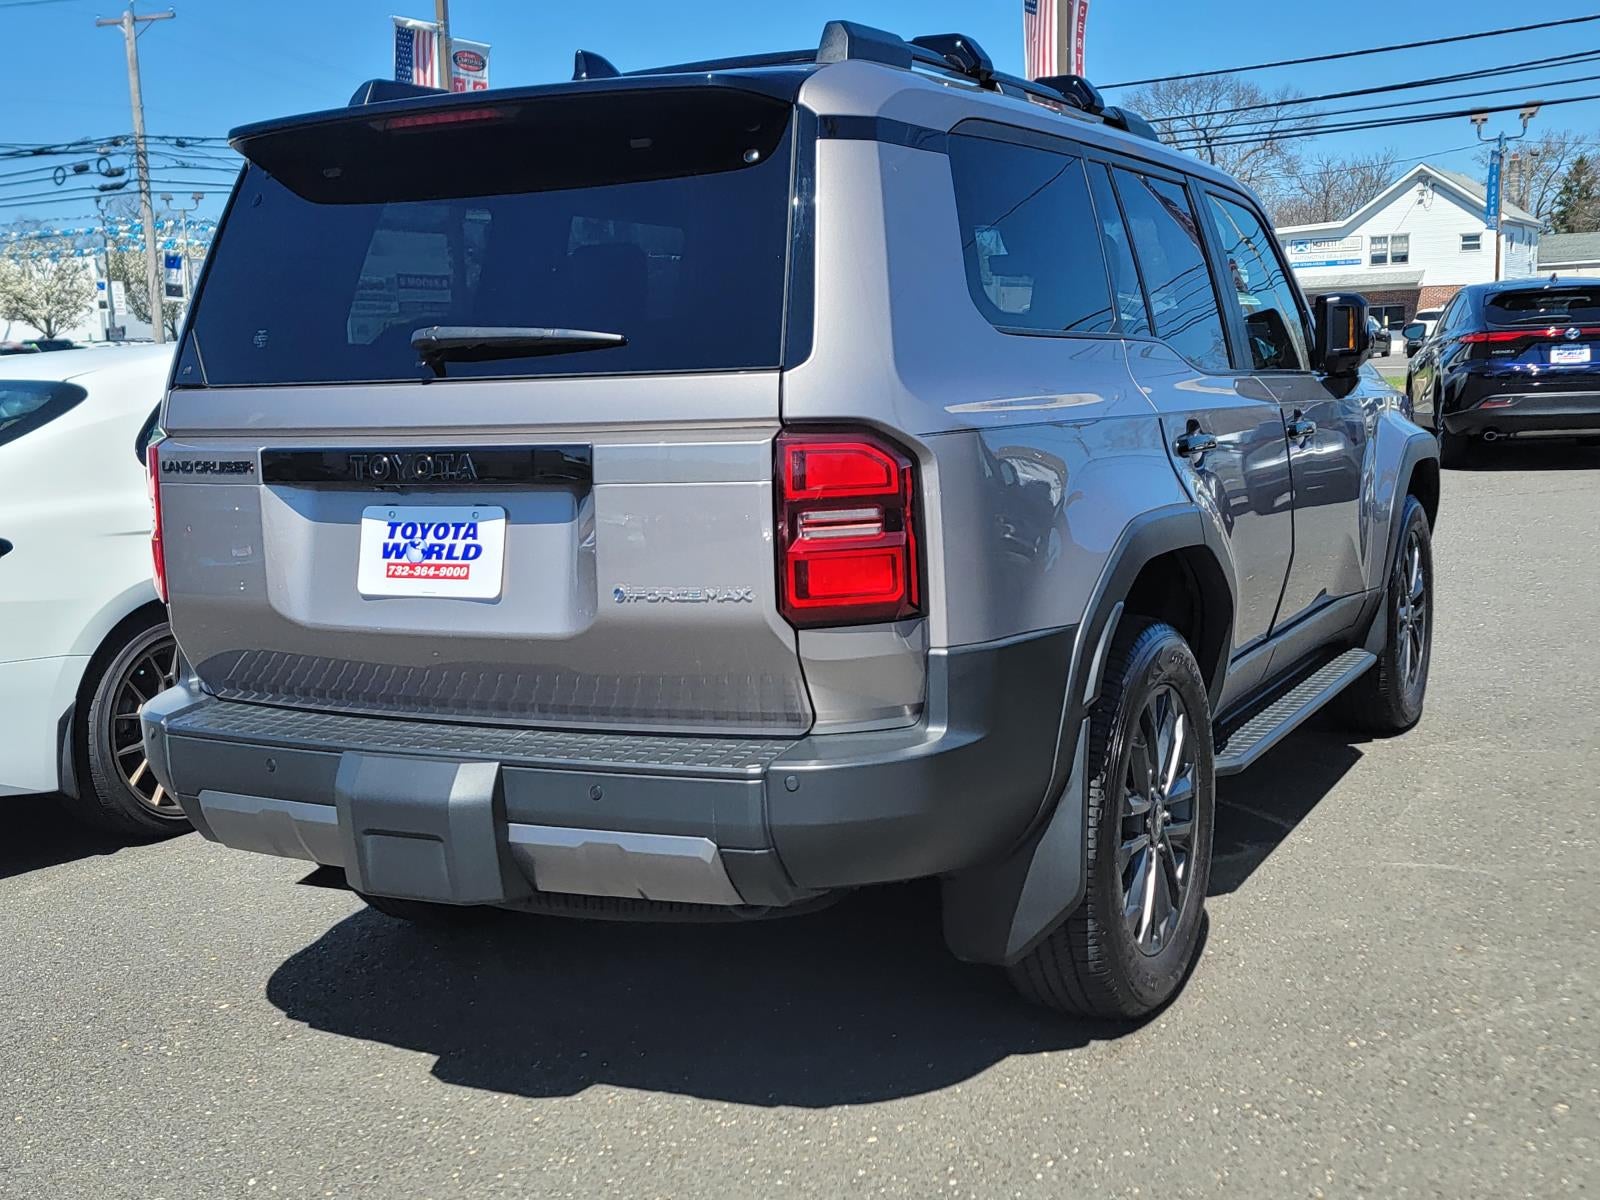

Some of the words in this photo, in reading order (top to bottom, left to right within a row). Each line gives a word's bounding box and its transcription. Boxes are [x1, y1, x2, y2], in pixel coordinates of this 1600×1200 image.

[161, 460, 193, 474] LAND
[349, 453, 479, 481] TOYOTA
[386, 521, 479, 541] TOYOTA
[387, 565, 468, 577] 732-364-9000
[704, 585, 753, 603] MAX
